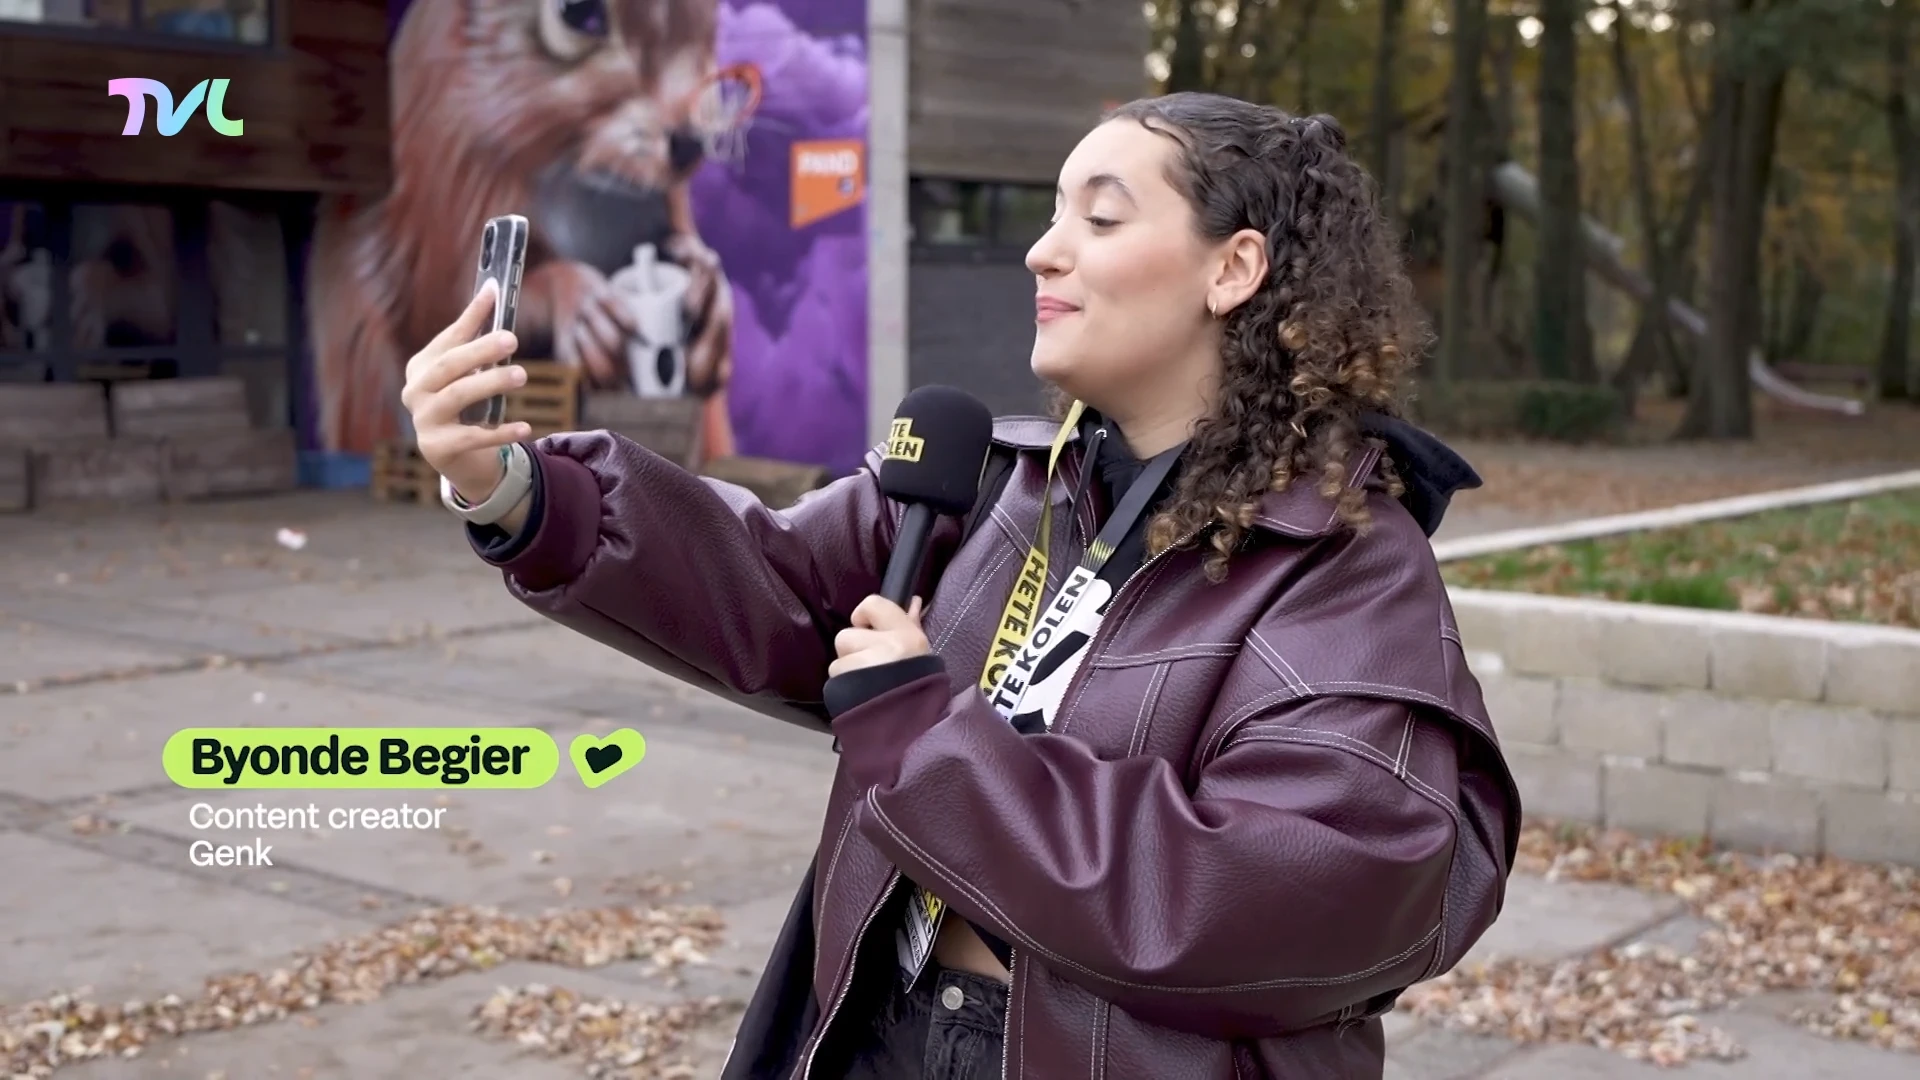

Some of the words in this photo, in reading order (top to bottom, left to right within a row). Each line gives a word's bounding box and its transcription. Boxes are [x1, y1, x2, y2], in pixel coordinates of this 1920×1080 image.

[888, 440, 918, 458] LEN
[892, 423, 908, 438] TE
[1004, 555, 1046, 637] HETE
[984, 638, 1022, 695] KO
[992, 674, 1025, 710] TE
[1015, 573, 1089, 673] KOLEN
